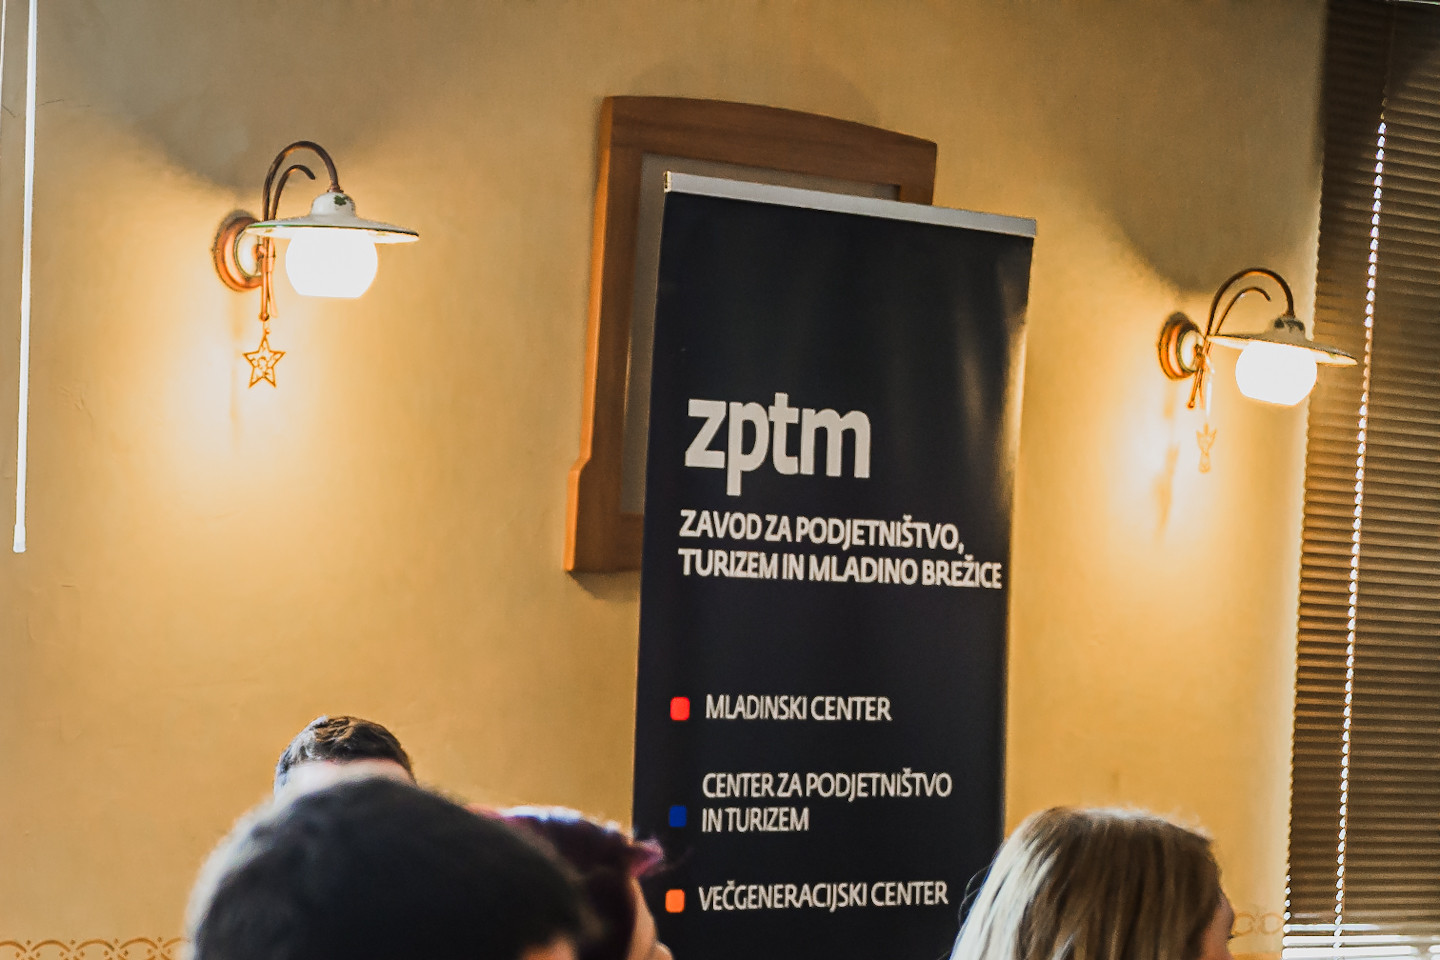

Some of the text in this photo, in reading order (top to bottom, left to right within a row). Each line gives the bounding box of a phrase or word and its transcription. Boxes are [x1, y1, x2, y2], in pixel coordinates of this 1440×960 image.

[685, 392, 871, 496] zptm
[679, 509, 964, 554] ZAVOD ZA PODJETNIŠTVO,
[678, 548, 1002, 589] TURIZEM IN MLADINO BREŽICE
[705, 694, 893, 721] MLADINSKI CENTER
[702, 767, 953, 802] CENTER ZA PODJETNIŠTVO
[702, 807, 810, 832] IN TURIZEM
[698, 880, 949, 913] VEČGENERACIJSKI CENTER
